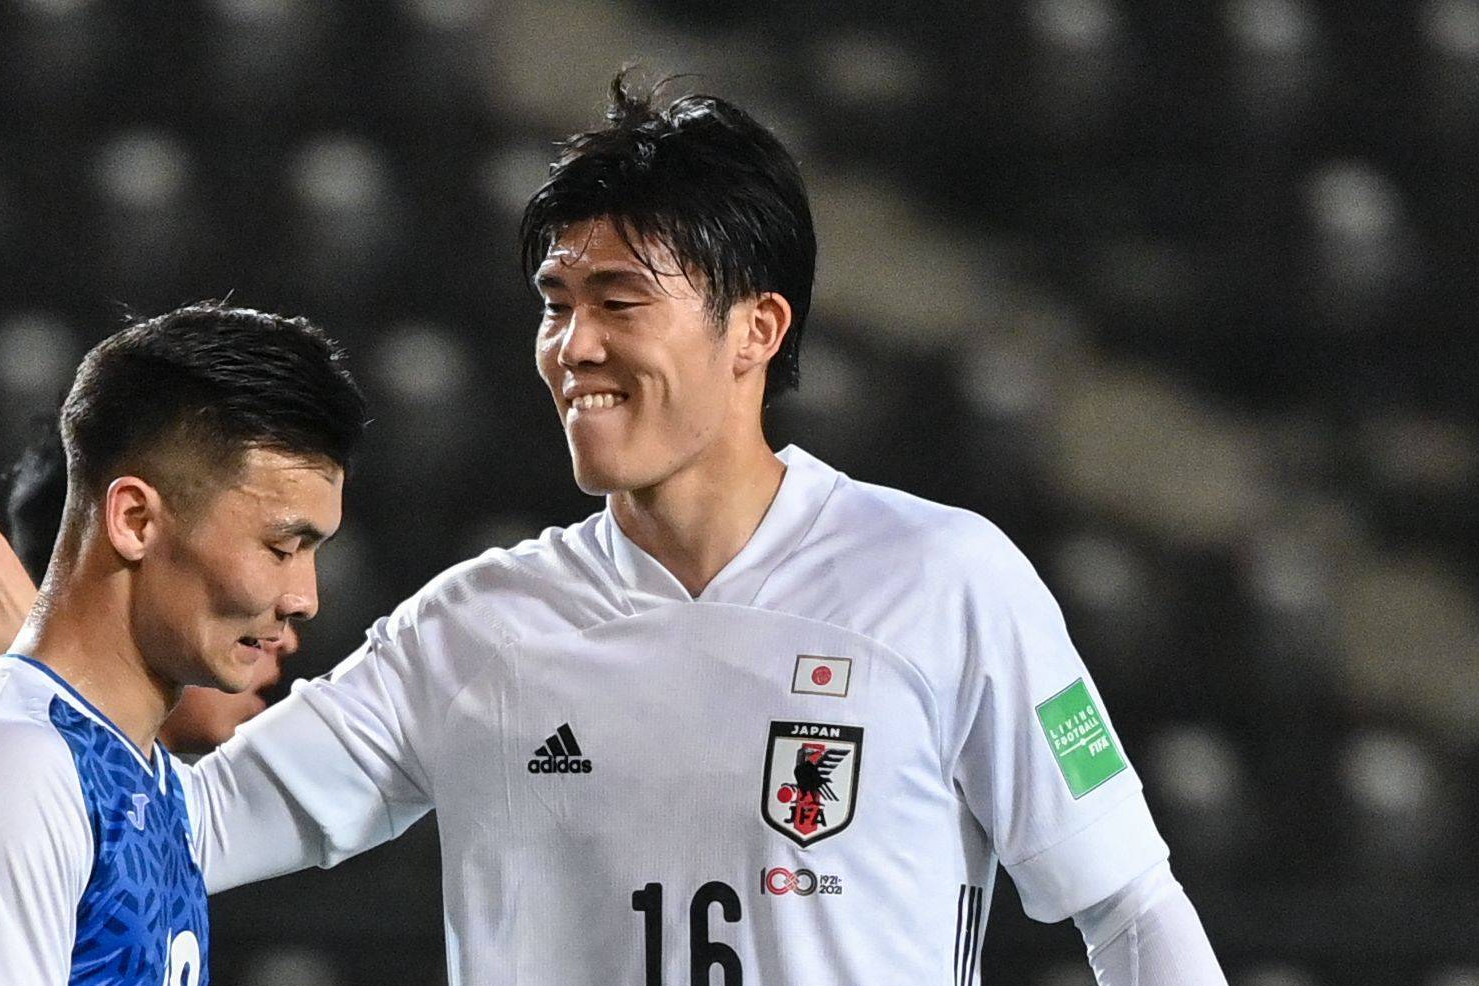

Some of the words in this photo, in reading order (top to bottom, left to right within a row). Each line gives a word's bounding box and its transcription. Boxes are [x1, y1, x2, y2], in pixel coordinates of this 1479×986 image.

[790, 725, 841, 738] JAPAN
[1049, 705, 1095, 739] LIVING
[1054, 717, 1099, 750] FOOTBALL
[1087, 735, 1110, 757] FIFA
[527, 756, 593, 774] adidas
[783, 806, 827, 828] JFA
